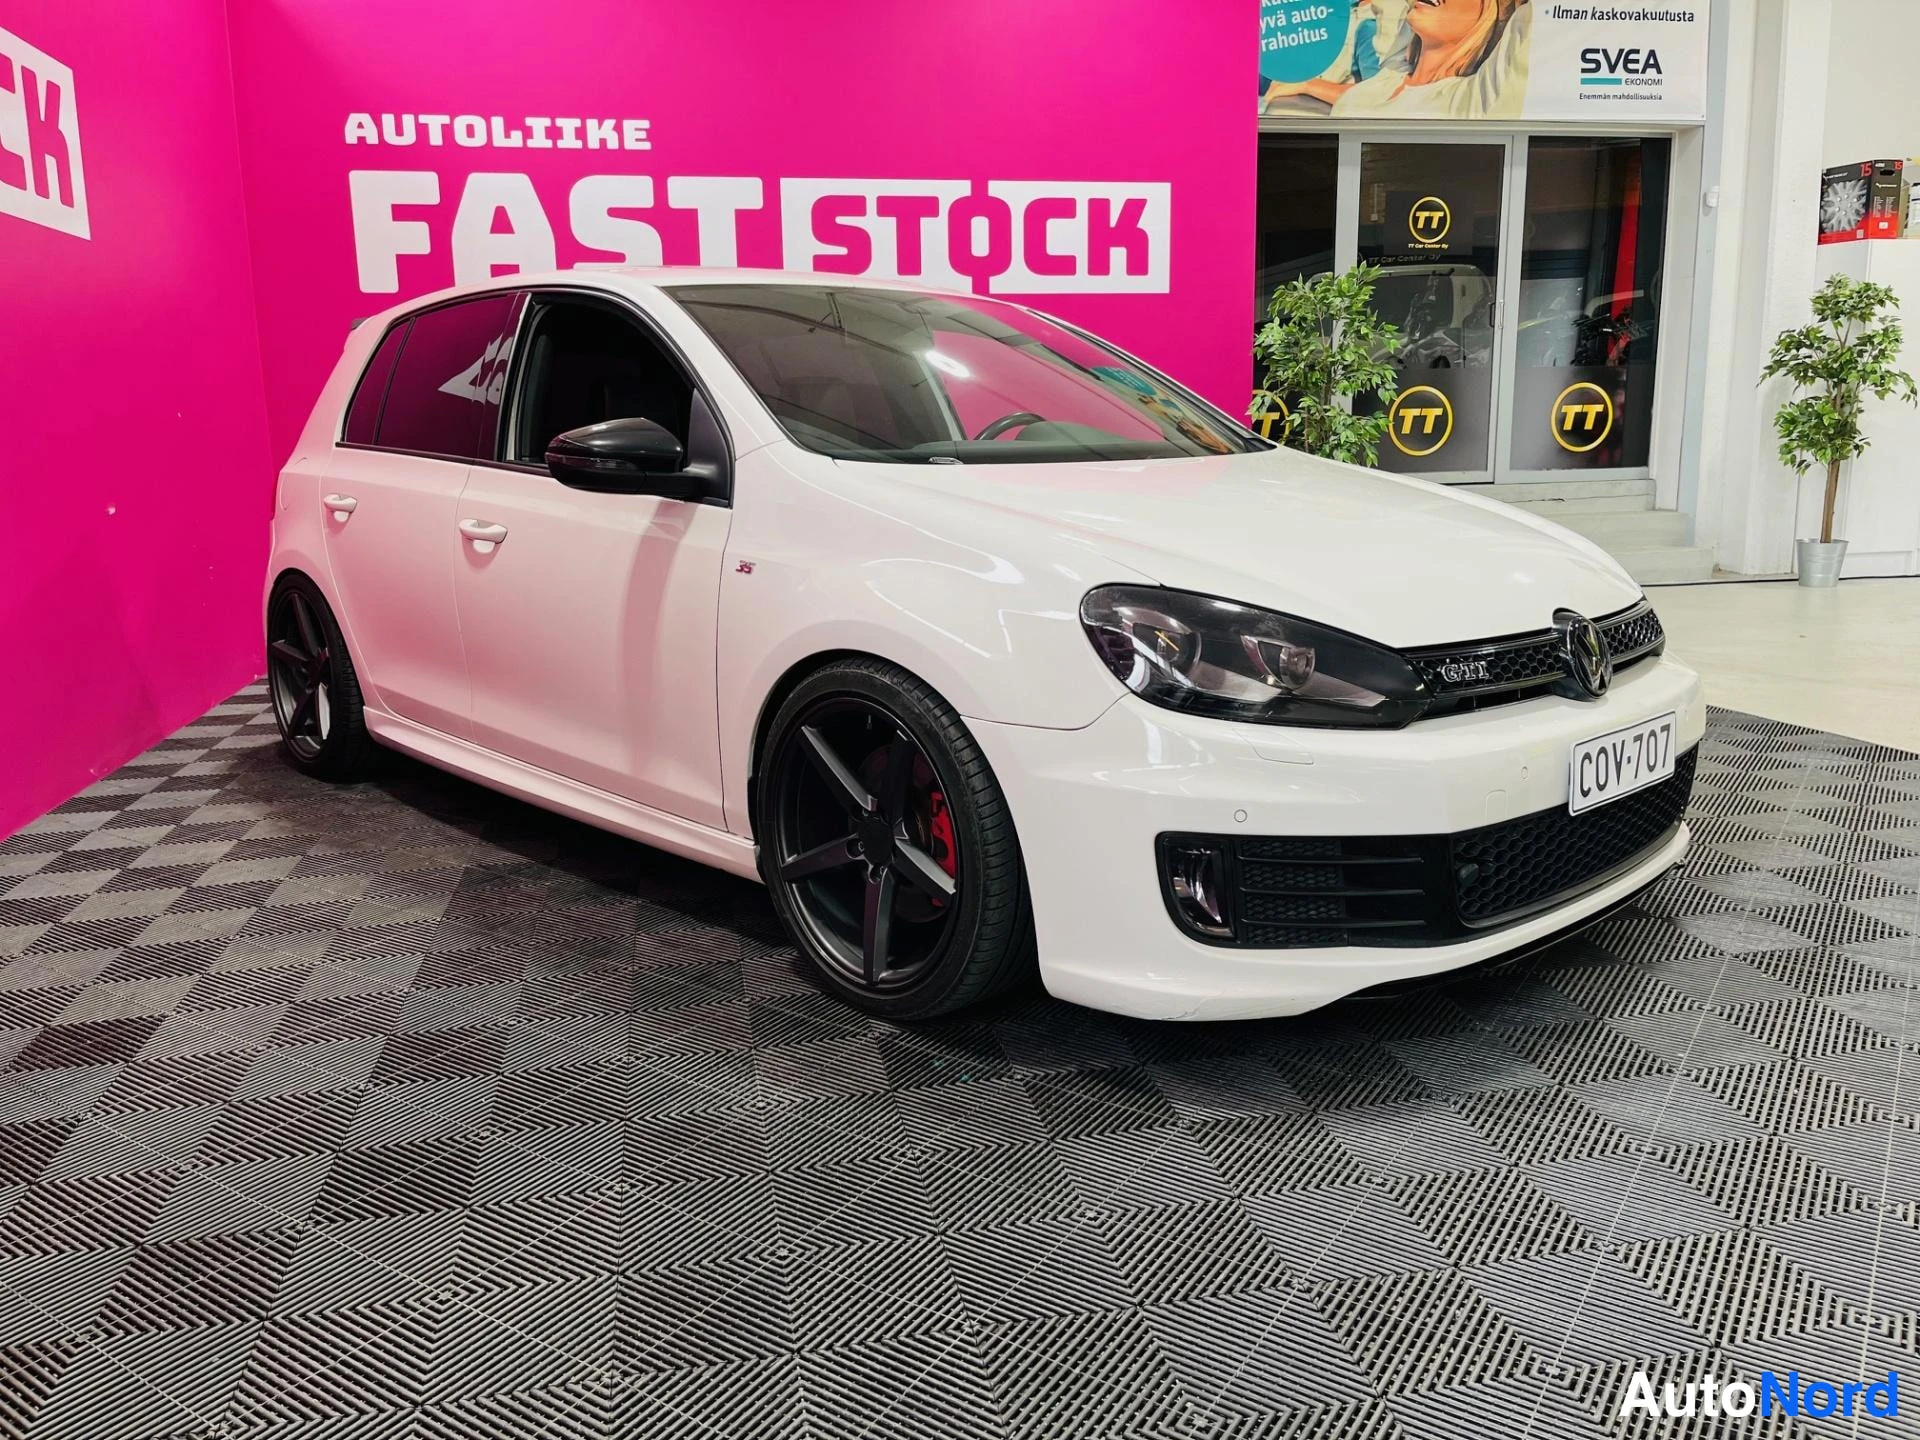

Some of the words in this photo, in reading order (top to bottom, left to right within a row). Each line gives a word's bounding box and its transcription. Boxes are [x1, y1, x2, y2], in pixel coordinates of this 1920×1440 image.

[1291, 5, 1334, 24] auto-
[1553, 5, 1588, 20] Ilman
[1591, 7, 1695, 22] kaskovakuutusta
[1261, 27, 1328, 52] rahoitus
[1580, 48, 1662, 74] SVEA
[1624, 78, 1662, 86] EKONOMI
[1580, 92, 1611, 100] Enemmän
[1612, 92, 1662, 100] mahdollisuuksia
[344, 112, 652, 150] AUTOLIIKE
[348, 170, 764, 294] FAST
[811, 188, 1149, 282] STOCK
[1415, 210, 1444, 229] TT
[1399, 407, 1443, 434] TT
[1561, 404, 1604, 430] TT
[1441, 660, 1490, 682] GTI
[1579, 723, 1671, 798] COV-707
